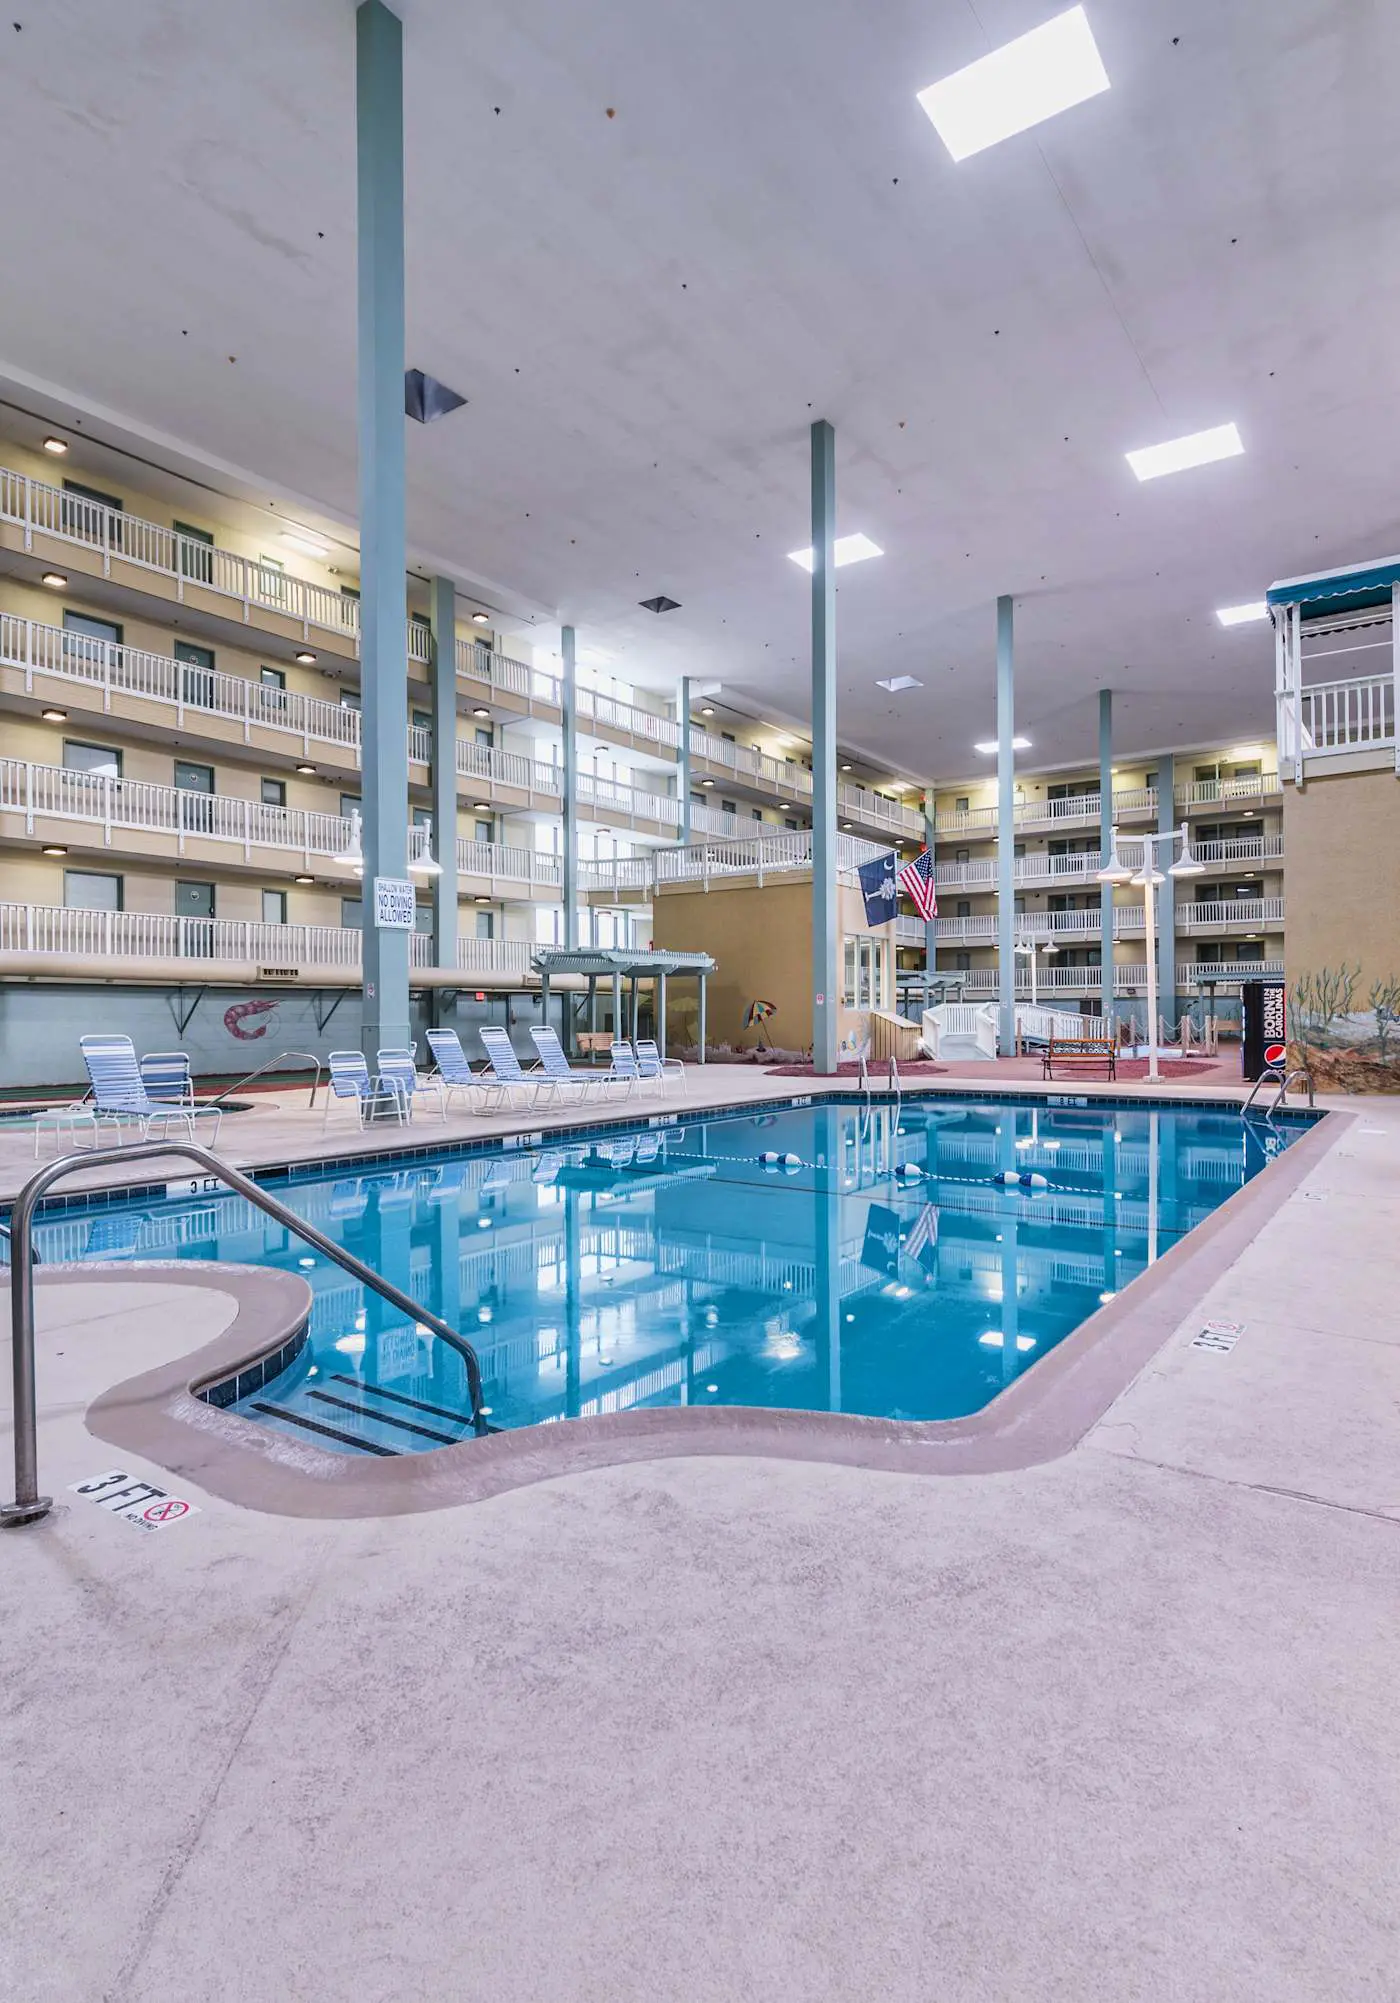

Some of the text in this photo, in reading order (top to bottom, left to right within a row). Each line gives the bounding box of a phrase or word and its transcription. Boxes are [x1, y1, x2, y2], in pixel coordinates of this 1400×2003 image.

[378, 883, 412, 895] SHALLOW WATER
[378, 894, 412, 909] NO DIVING
[380, 909, 412, 923] ALLOWED
[1264, 987, 1276, 1038] BORN IN
[1275, 987, 1284, 1039] CAROLINAS
[1193, 1329, 1238, 1351] 3 FT
[77, 1474, 168, 1512] 3 FT
